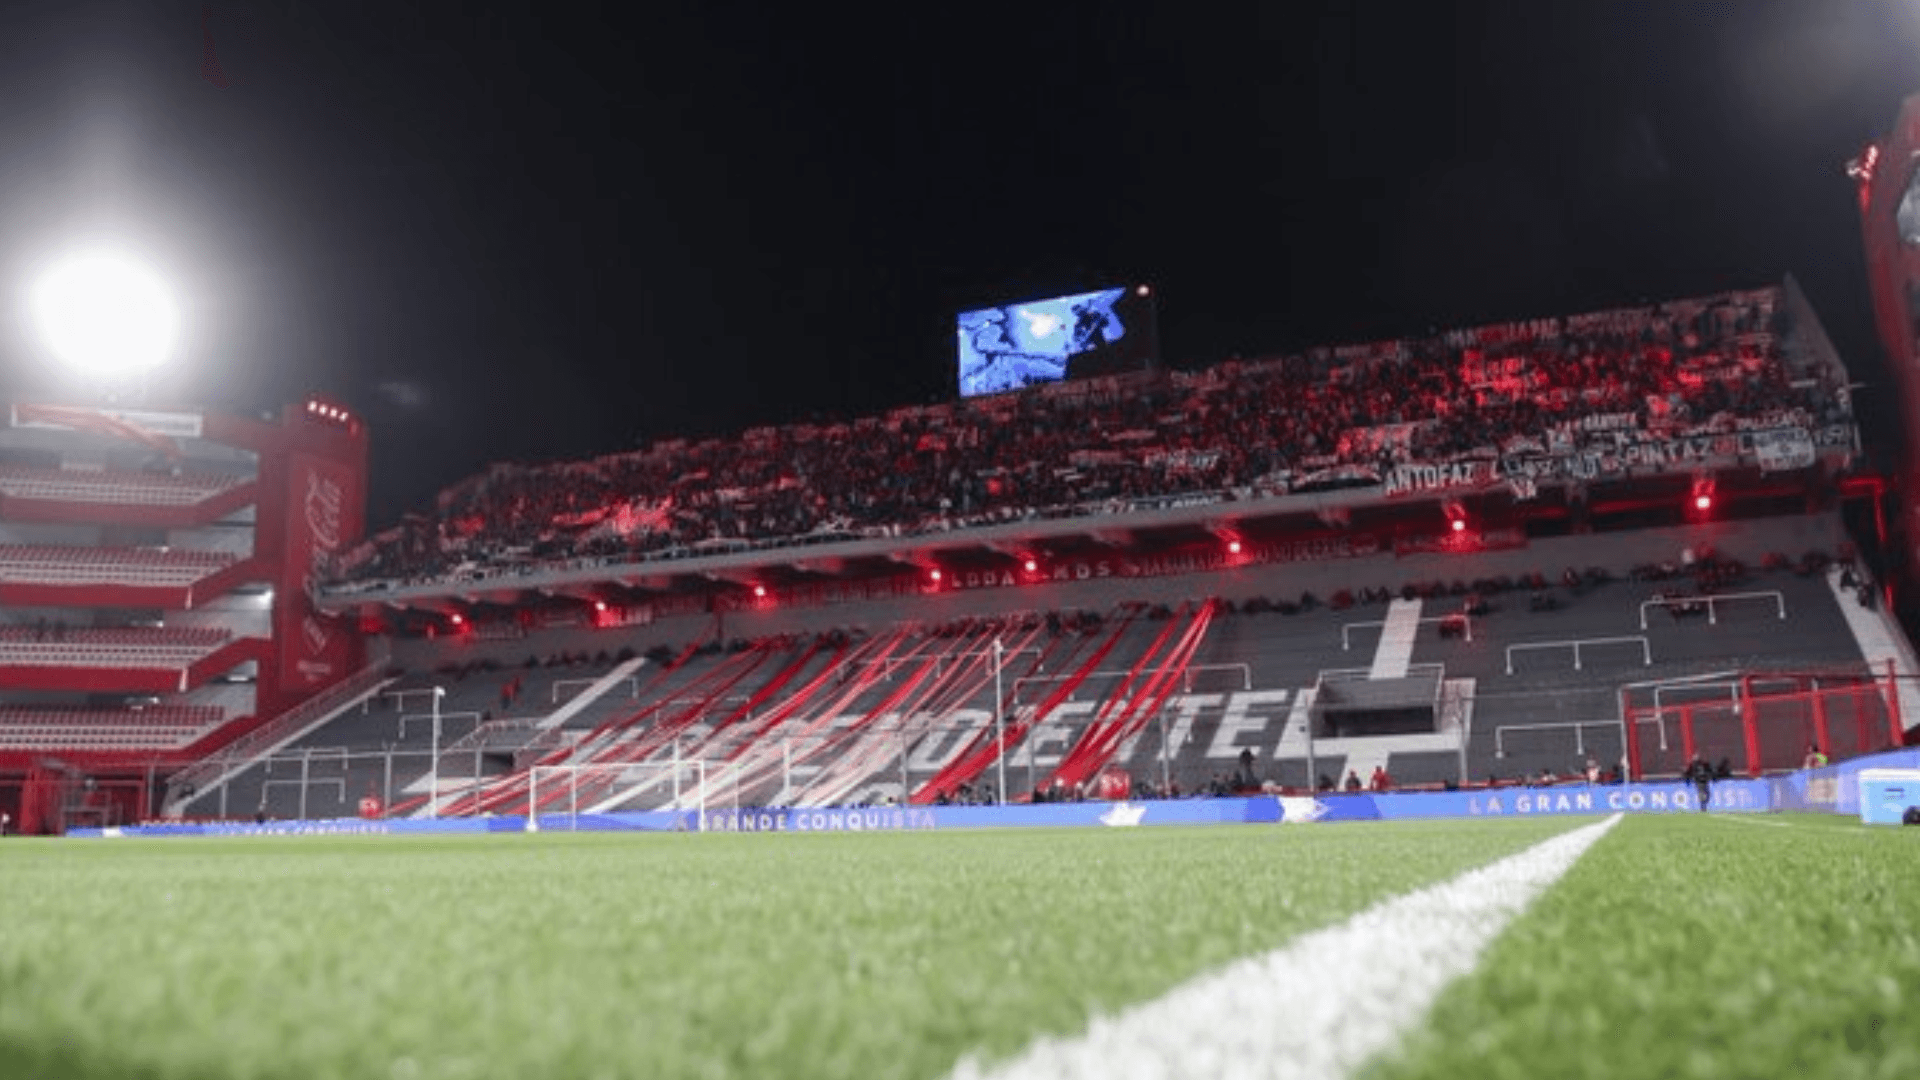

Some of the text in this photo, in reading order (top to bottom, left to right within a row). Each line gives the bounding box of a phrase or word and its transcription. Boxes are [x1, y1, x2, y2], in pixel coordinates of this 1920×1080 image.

[1469, 787, 1755, 815] LA GRAN CONQIST
[795, 810, 937, 832] CONQUISTA
